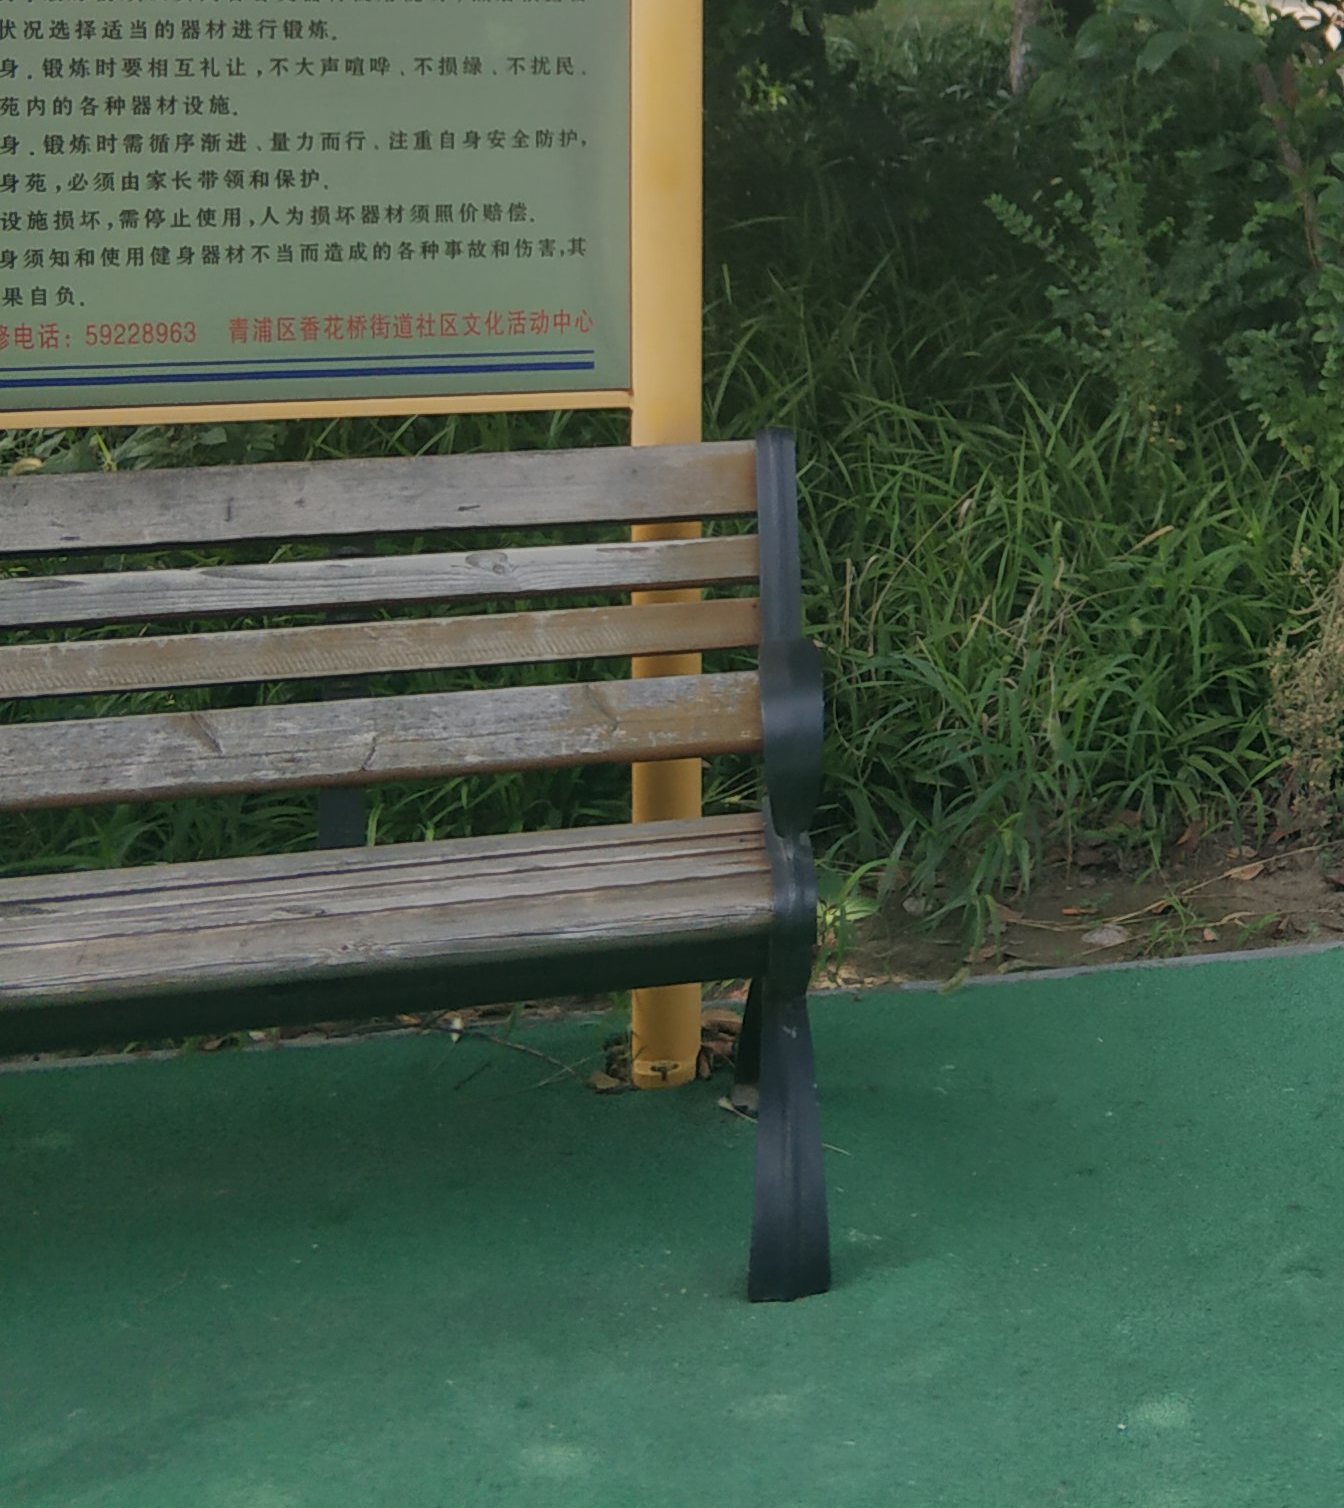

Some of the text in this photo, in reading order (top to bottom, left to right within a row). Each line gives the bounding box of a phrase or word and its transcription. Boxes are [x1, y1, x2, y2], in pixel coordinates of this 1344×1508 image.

[229, 309, 594, 344] 青浦区香花桥街道社区文化活动中心
